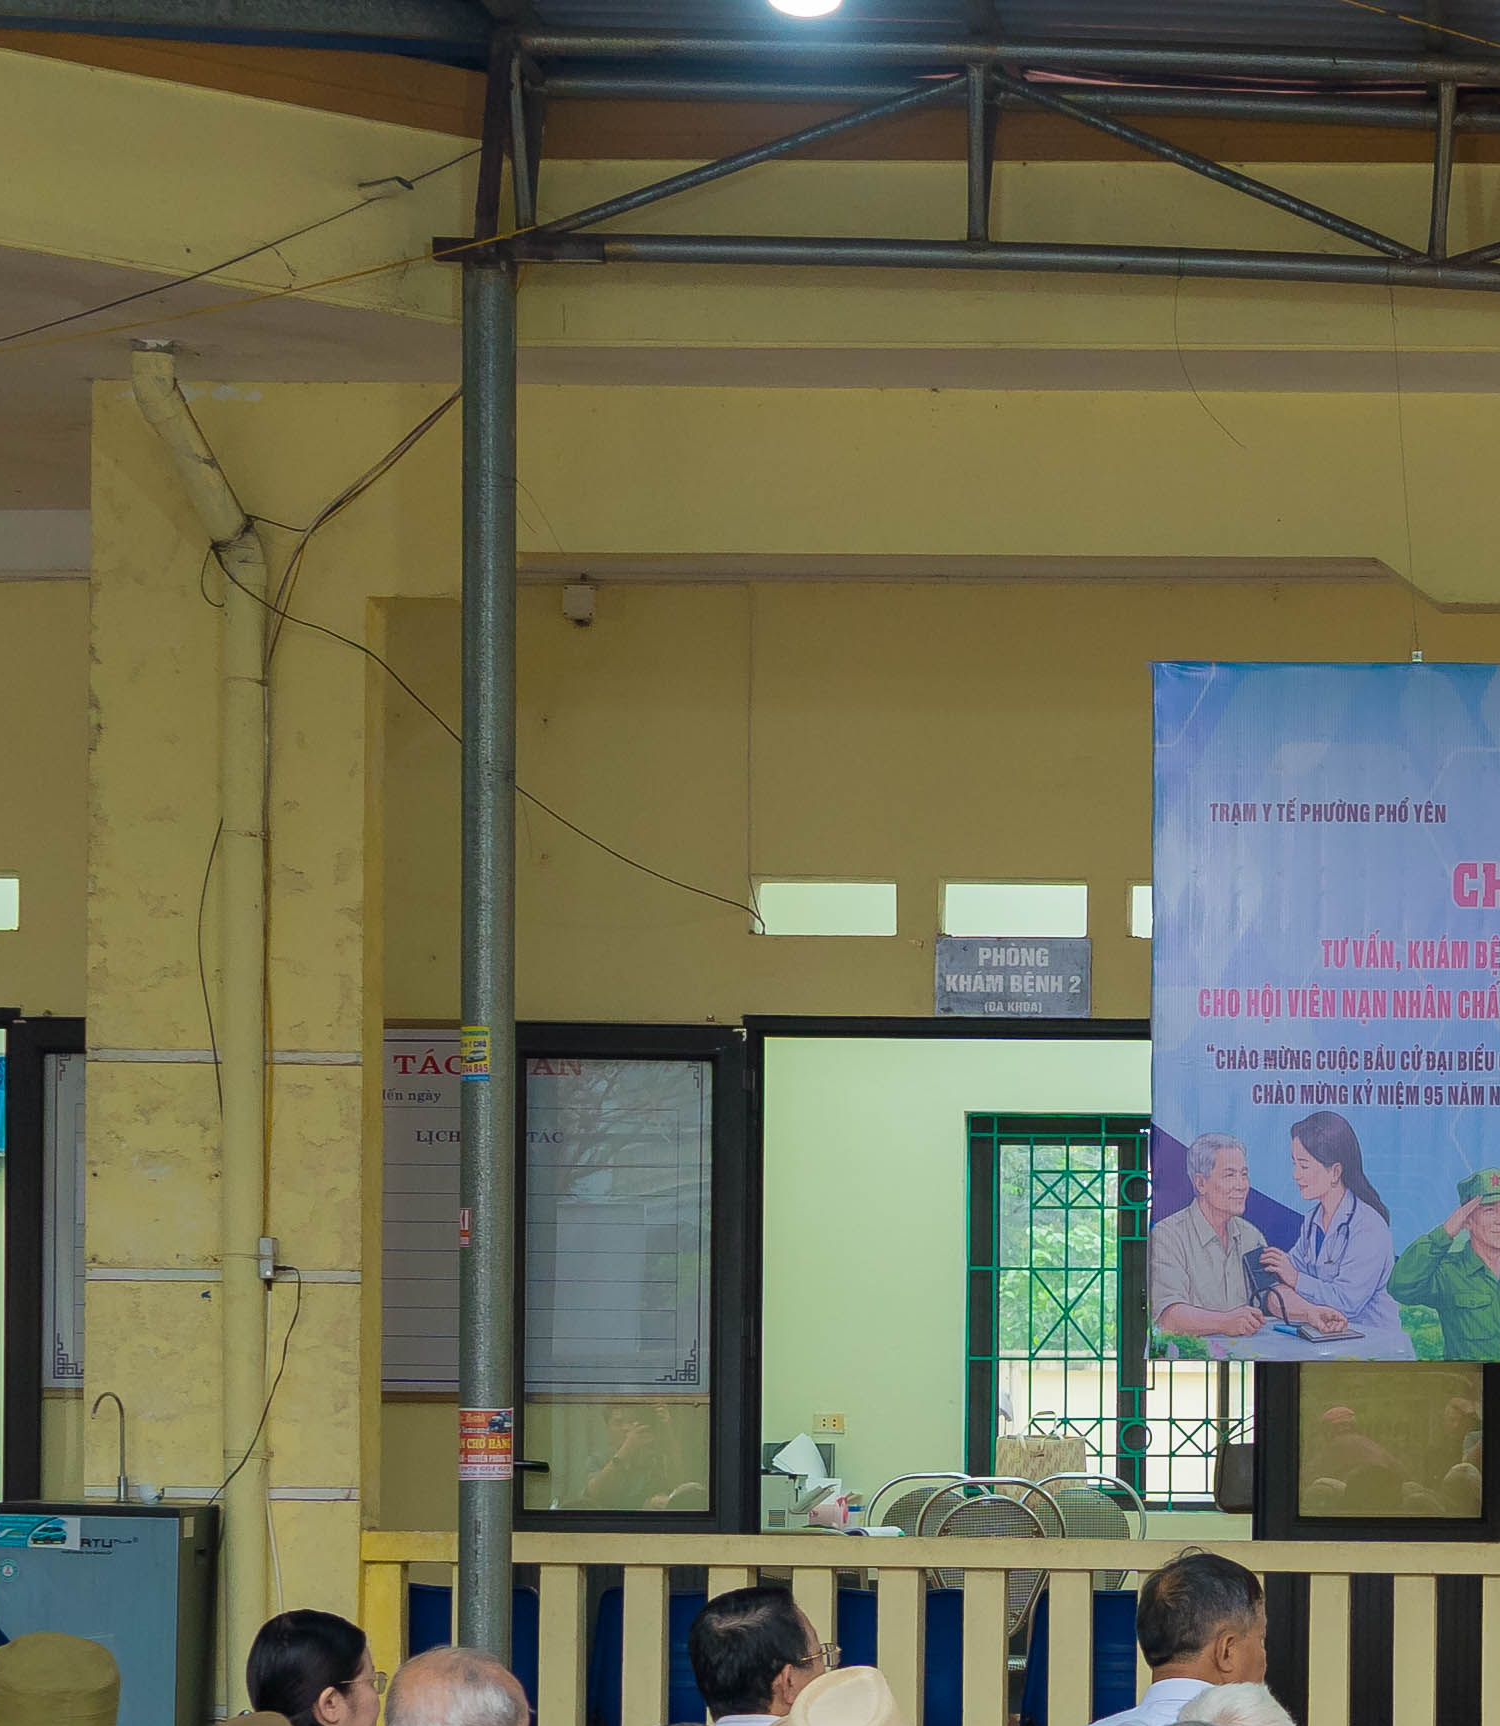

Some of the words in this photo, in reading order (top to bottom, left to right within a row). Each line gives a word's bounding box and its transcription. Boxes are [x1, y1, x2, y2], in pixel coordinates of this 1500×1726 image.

[1209, 802, 1256, 827] TRẠM
[1262, 803, 1273, 823] Y
[1275, 798, 1298, 823] TẾ
[1300, 799, 1370, 823] PHƯỜNG
[1375, 797, 1410, 824] PHỔ
[1413, 799, 1447, 824] YÊN
[978, 942, 1050, 967] PHÒNG
[1321, 936, 1350, 969] TƯ
[1352, 929, 1401, 972] VẤN,
[1407, 935, 1468, 970] KHÁM
[945, 970, 1004, 993] KHÁM
[1010, 971, 1063, 997] BỆNH
[1068, 975, 1082, 993] 2
[1198, 989, 1241, 1019] CHO
[1246, 983, 1282, 1025] HỘI
[1288, 983, 1335, 1019] VIÊN
[1342, 990, 1387, 1025] NẠN
[1393, 984, 1451, 1020] NHÂN
[1263, 1046, 1311, 1072] MỪNG
[1316, 1048, 1360, 1076] CUỘC
[1364, 1044, 1396, 1072] BẦU
[1400, 1044, 1422, 1072] CỬ
[1425, 1051, 1453, 1076] ĐẠI
[1457, 1043, 1495, 1073] BIỂU
[408, 1089, 442, 1104] ngày
[1252, 1082, 1296, 1106] CHÀO
[1300, 1081, 1349, 1106] MỪNG
[1353, 1080, 1373, 1106] KỶ
[1378, 1084, 1420, 1110] NIỆM
[1424, 1086, 1444, 1106] 95
[1448, 1083, 1485, 1106] NĂM
